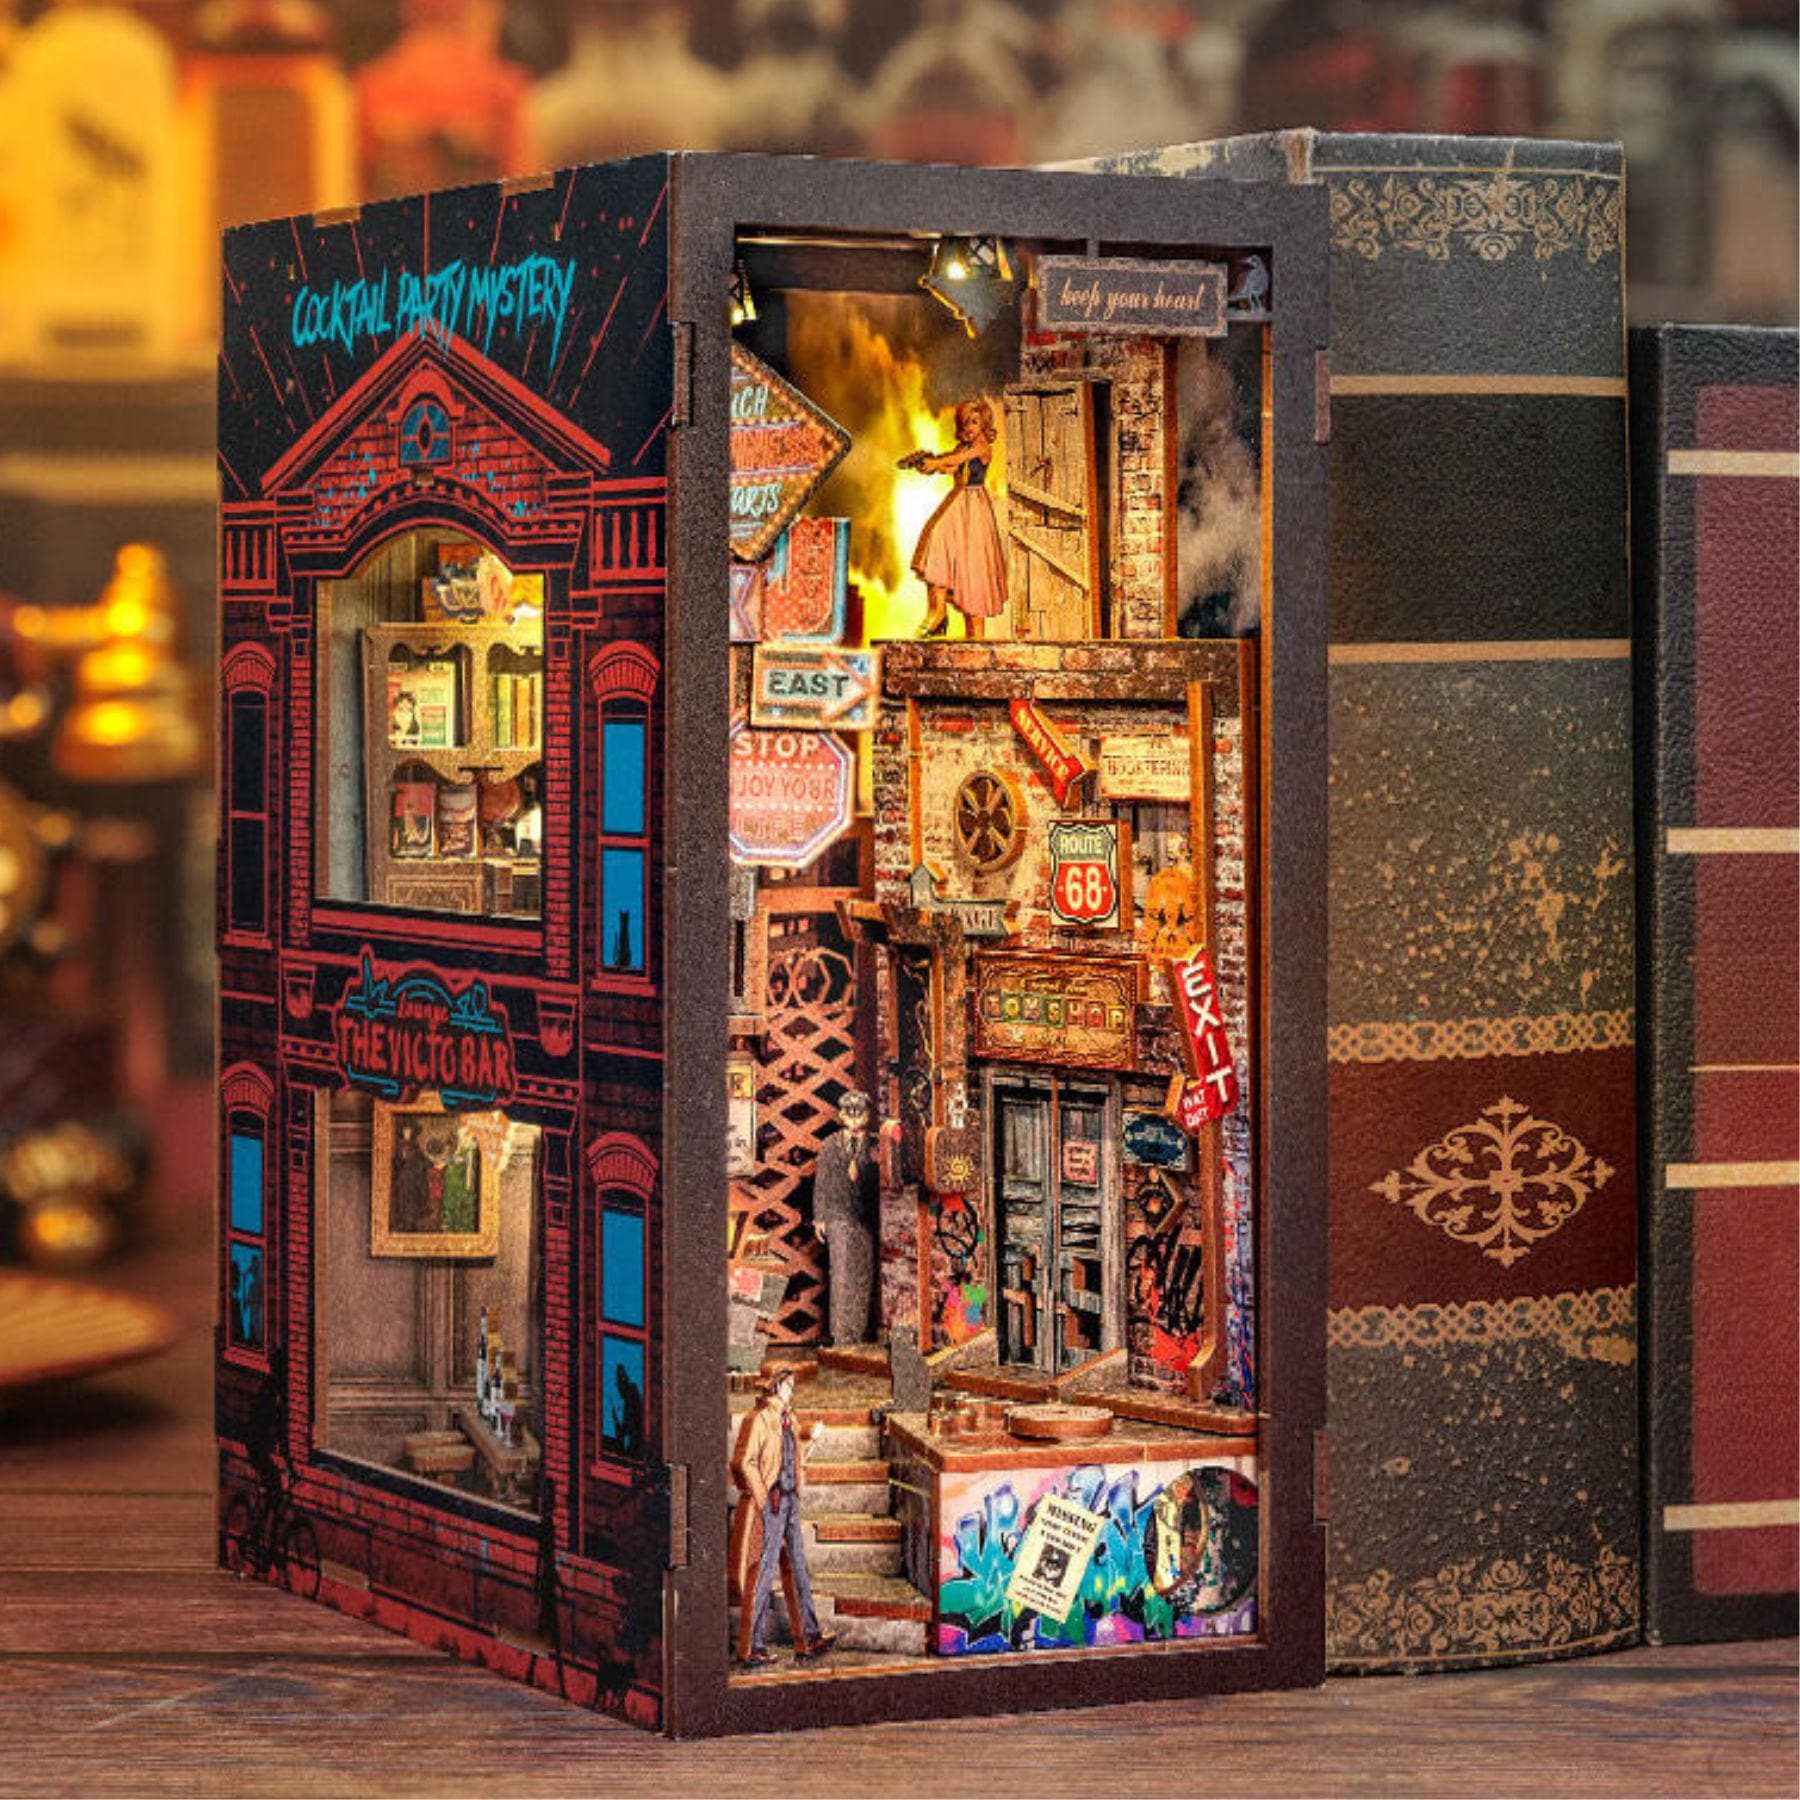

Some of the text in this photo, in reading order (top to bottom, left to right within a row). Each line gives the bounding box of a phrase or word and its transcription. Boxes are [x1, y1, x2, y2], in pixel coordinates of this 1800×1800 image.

[293, 252, 576, 378] COCKTAIL PARTY MYSTERY
[1103, 291, 1149, 320] your
[768, 669, 849, 697] EAST
[734, 731, 820, 758] STOP
[1015, 708, 1069, 782] SERVICE
[1060, 834, 1105, 855] ROUTE
[1065, 866, 1102, 911] 68
[339, 1014, 512, 1092] THE VICTO BAR
[1182, 961, 1233, 1103] EXIT
